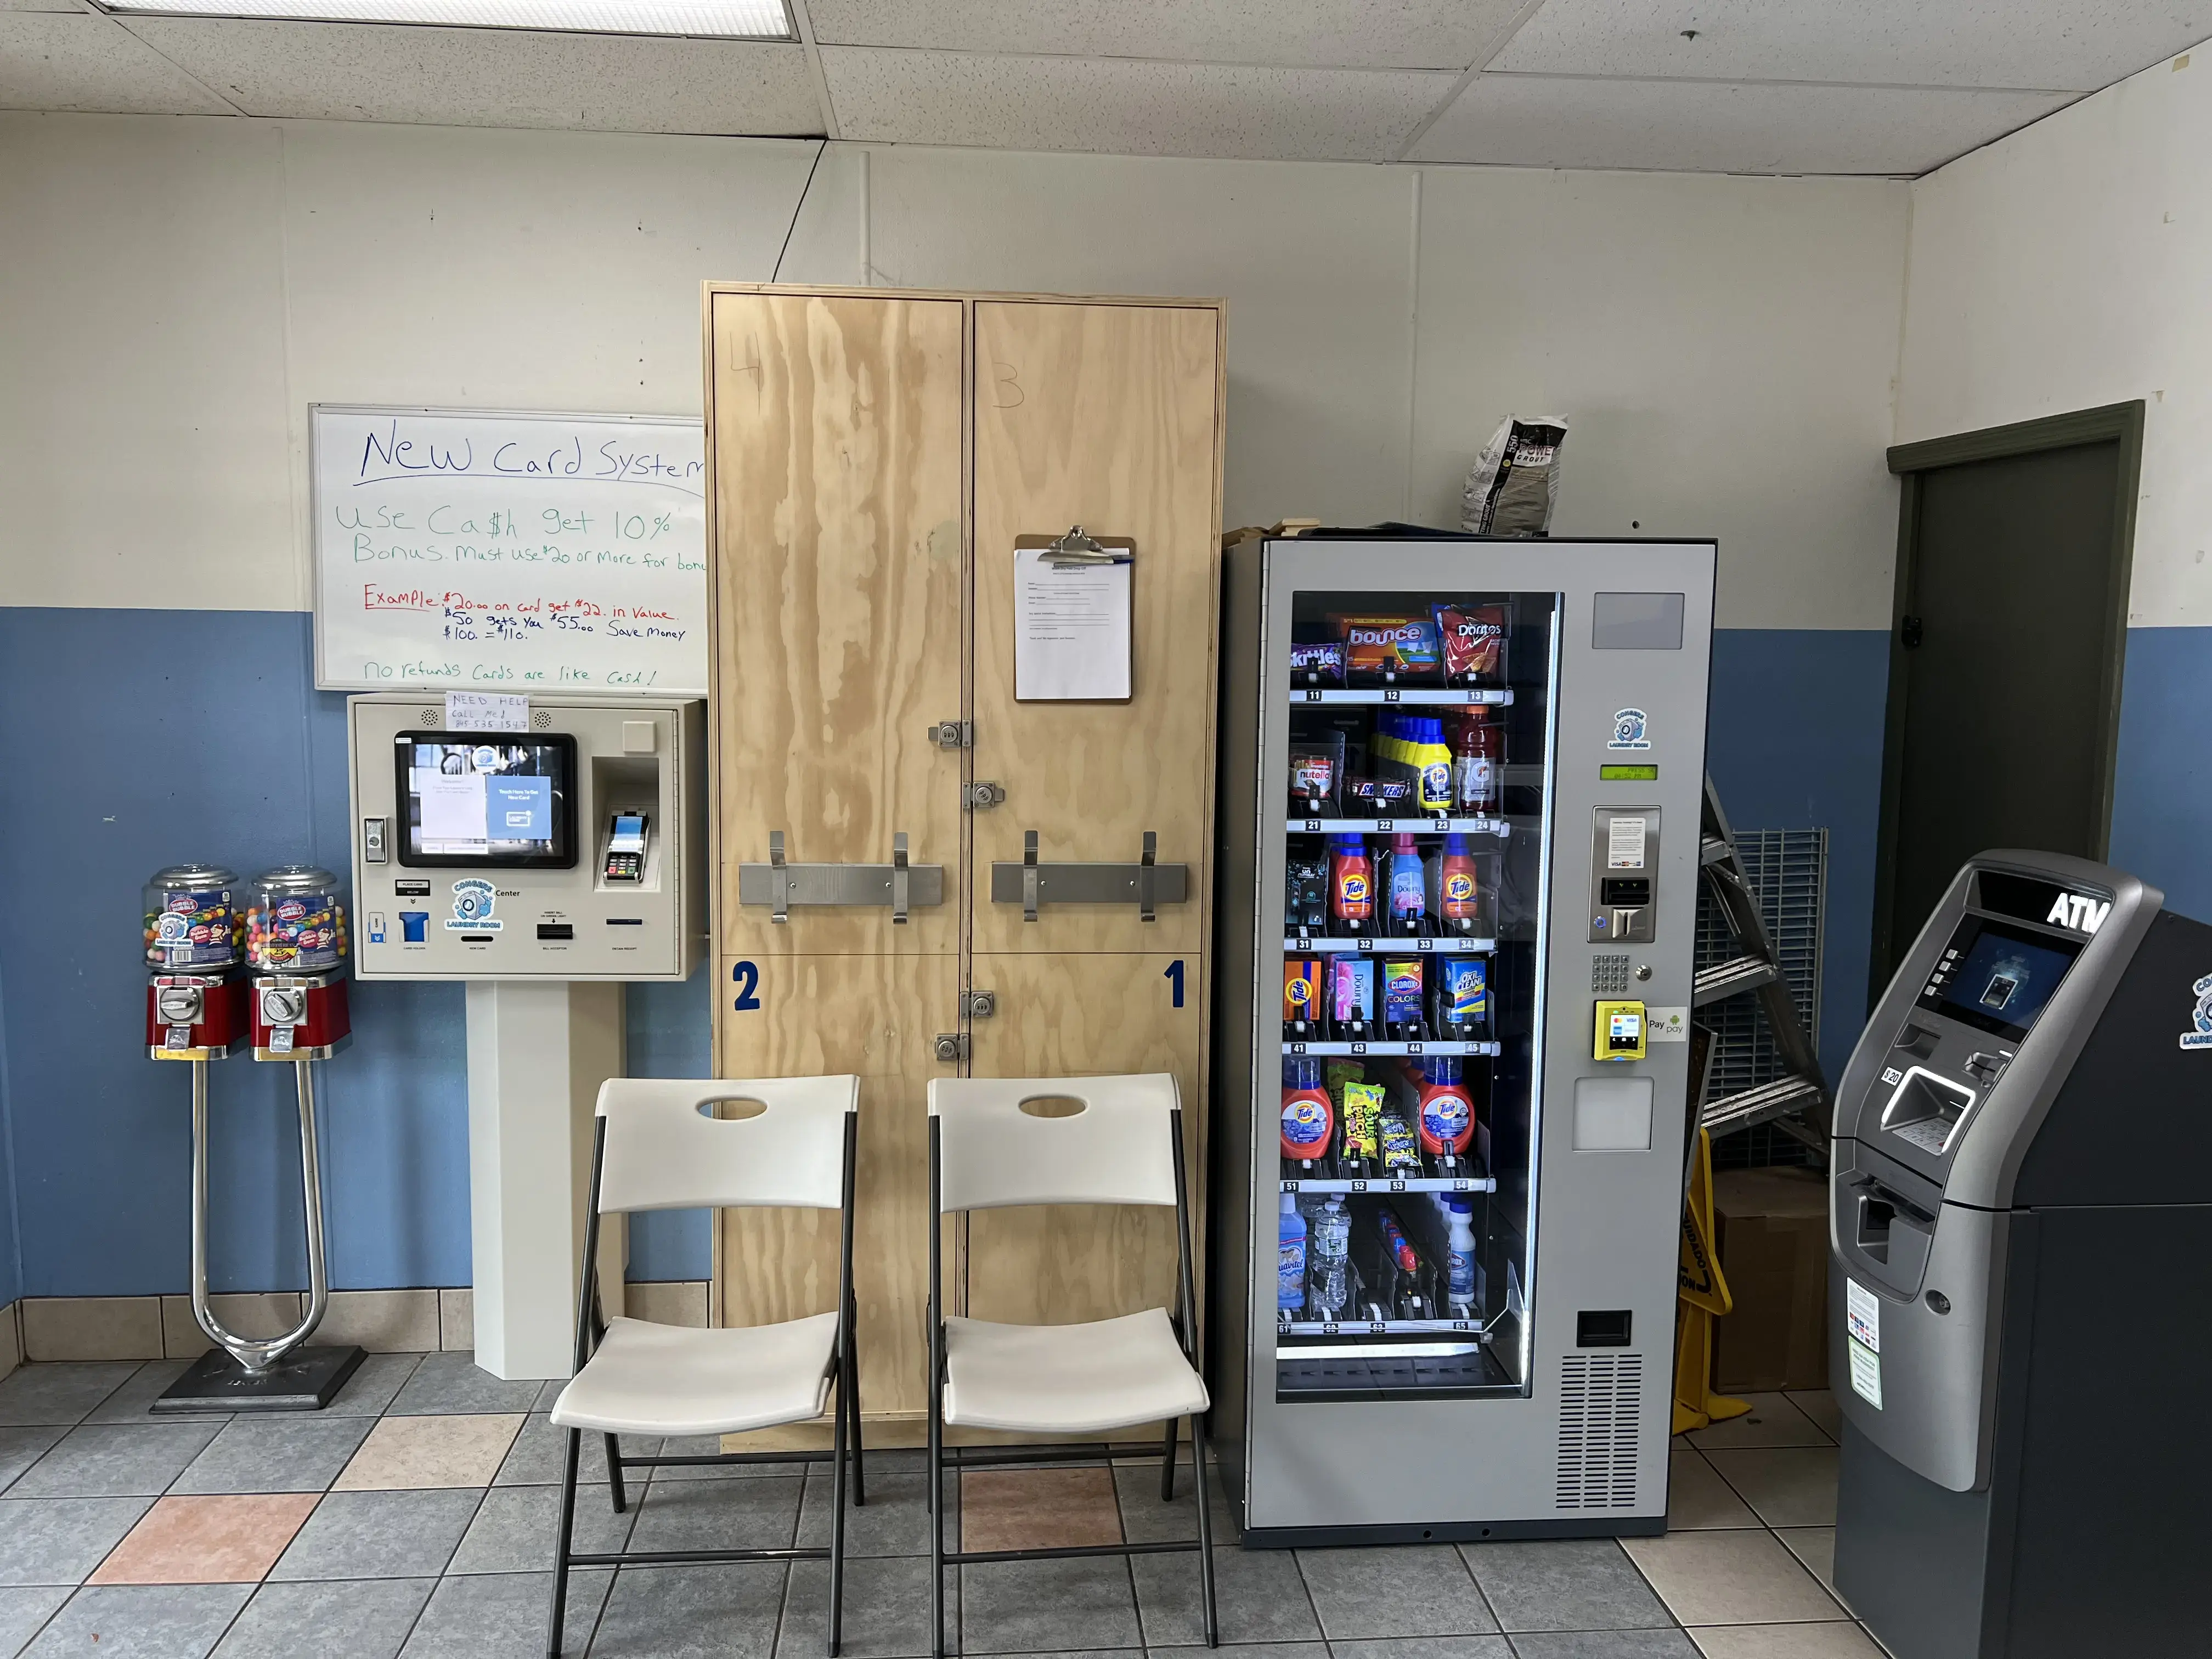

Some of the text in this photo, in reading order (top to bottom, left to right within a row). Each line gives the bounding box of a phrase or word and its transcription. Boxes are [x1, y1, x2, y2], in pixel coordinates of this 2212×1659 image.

[730, 331, 760, 415] 4
[992, 362, 1024, 408] 3
[1507, 435, 1518, 453] 550
[493, 436, 582, 475] Card
[428, 505, 517, 539] Ca$h
[543, 509, 594, 534] get
[616, 511, 671, 540] 10%
[511, 547, 543, 561] use
[577, 551, 592, 562] or
[642, 554, 669, 568] for
[517, 599, 540, 613] card
[548, 600, 570, 613] get
[613, 605, 625, 617] in
[444, 607, 473, 625] $50
[486, 616, 517, 626] gets
[549, 613, 594, 632] $55.00
[606, 619, 644, 636] Save
[1350, 628, 1421, 645] bounce
[402, 661, 461, 678] refunds
[524, 670, 545, 680] are
[558, 665, 590, 680] like
[453, 694, 528, 707] NEED HELP
[1310, 692, 1319, 700] 11
[1387, 691, 1397, 699] 12
[1470, 691, 1481, 699] 13
[1300, 770, 1330, 779] nutella
[1362, 784, 1403, 797] SNKERS
[454, 880, 493, 893] CONGERS
[1345, 881, 1365, 896] Tide
[1451, 881, 1470, 895] Tide
[2046, 892, 2111, 934] ATM
[1461, 940, 1471, 948] 34
[733, 961, 760, 1011] 2
[1163, 960, 1184, 1008] 1
[1456, 977, 1482, 992] CLEAN
[1462, 972, 1476, 983] OXI
[1293, 980, 1307, 1001] Tide
[1351, 974, 1364, 1007] Downy
[1649, 1020, 1665, 1030] Pay
[1888, 1071, 1899, 1083] 20
[1297, 1108, 1313, 1119] Tide
[1440, 1103, 1455, 1115] Tide
[1352, 1105, 1367, 1139] PATCH
[1364, 1107, 1375, 1138] SOUR
[1278, 1259, 1304, 1272] uavitel
